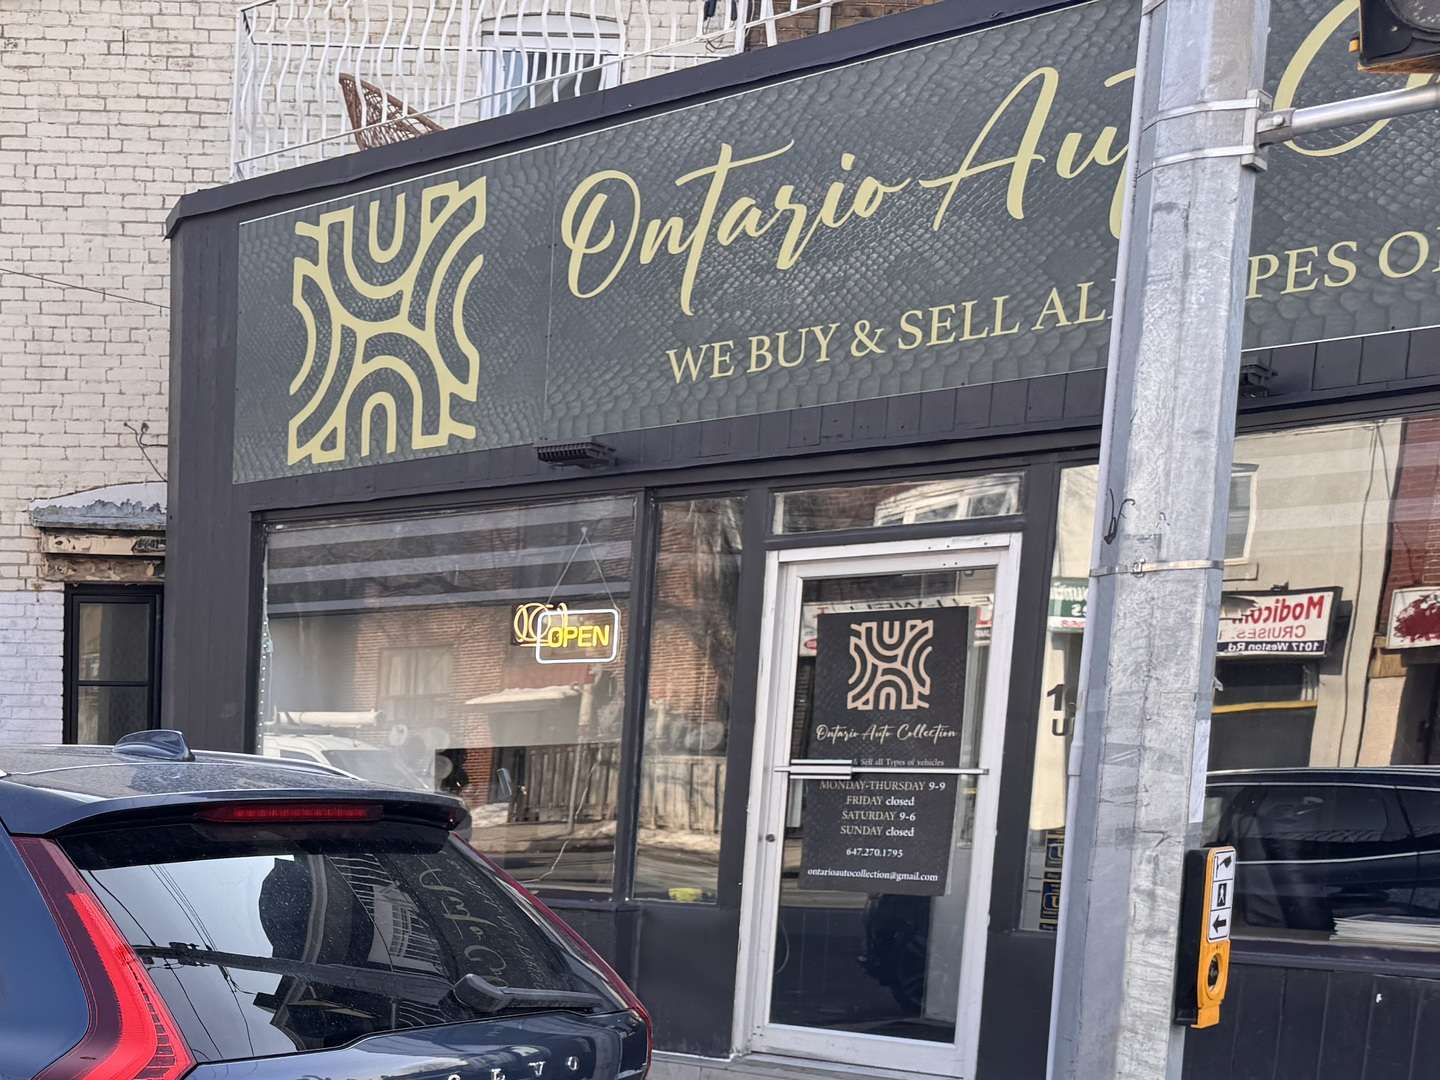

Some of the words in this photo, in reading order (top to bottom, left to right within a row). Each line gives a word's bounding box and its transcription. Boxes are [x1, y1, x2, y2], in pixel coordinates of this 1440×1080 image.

[561, 139, 910, 316] Ontario
[918, 66, 1137, 240] Au
[665, 340, 735, 384] WE
[746, 323, 840, 374] BUY
[850, 319, 886, 358] &
[897, 295, 1020, 351] SELL
[1031, 279, 1116, 331] AL
[1245, 240, 1358, 301] PES
[548, 625, 610, 648] OPEN
[816, 724, 859, 745] Ontario
[897, 723, 957, 745] Collection
[819, 780, 926, 791] MONDAY-THURSDAY
[928, 781, 946, 791] 9-9
[846, 795, 884, 806] FRIDAY
[885, 796, 915, 806] closed
[841, 810, 897, 820] SATURDAY
[899, 812, 916, 821] 9-6
[840, 825, 883, 836] SUNDAY
[885, 827, 915, 837] closed
